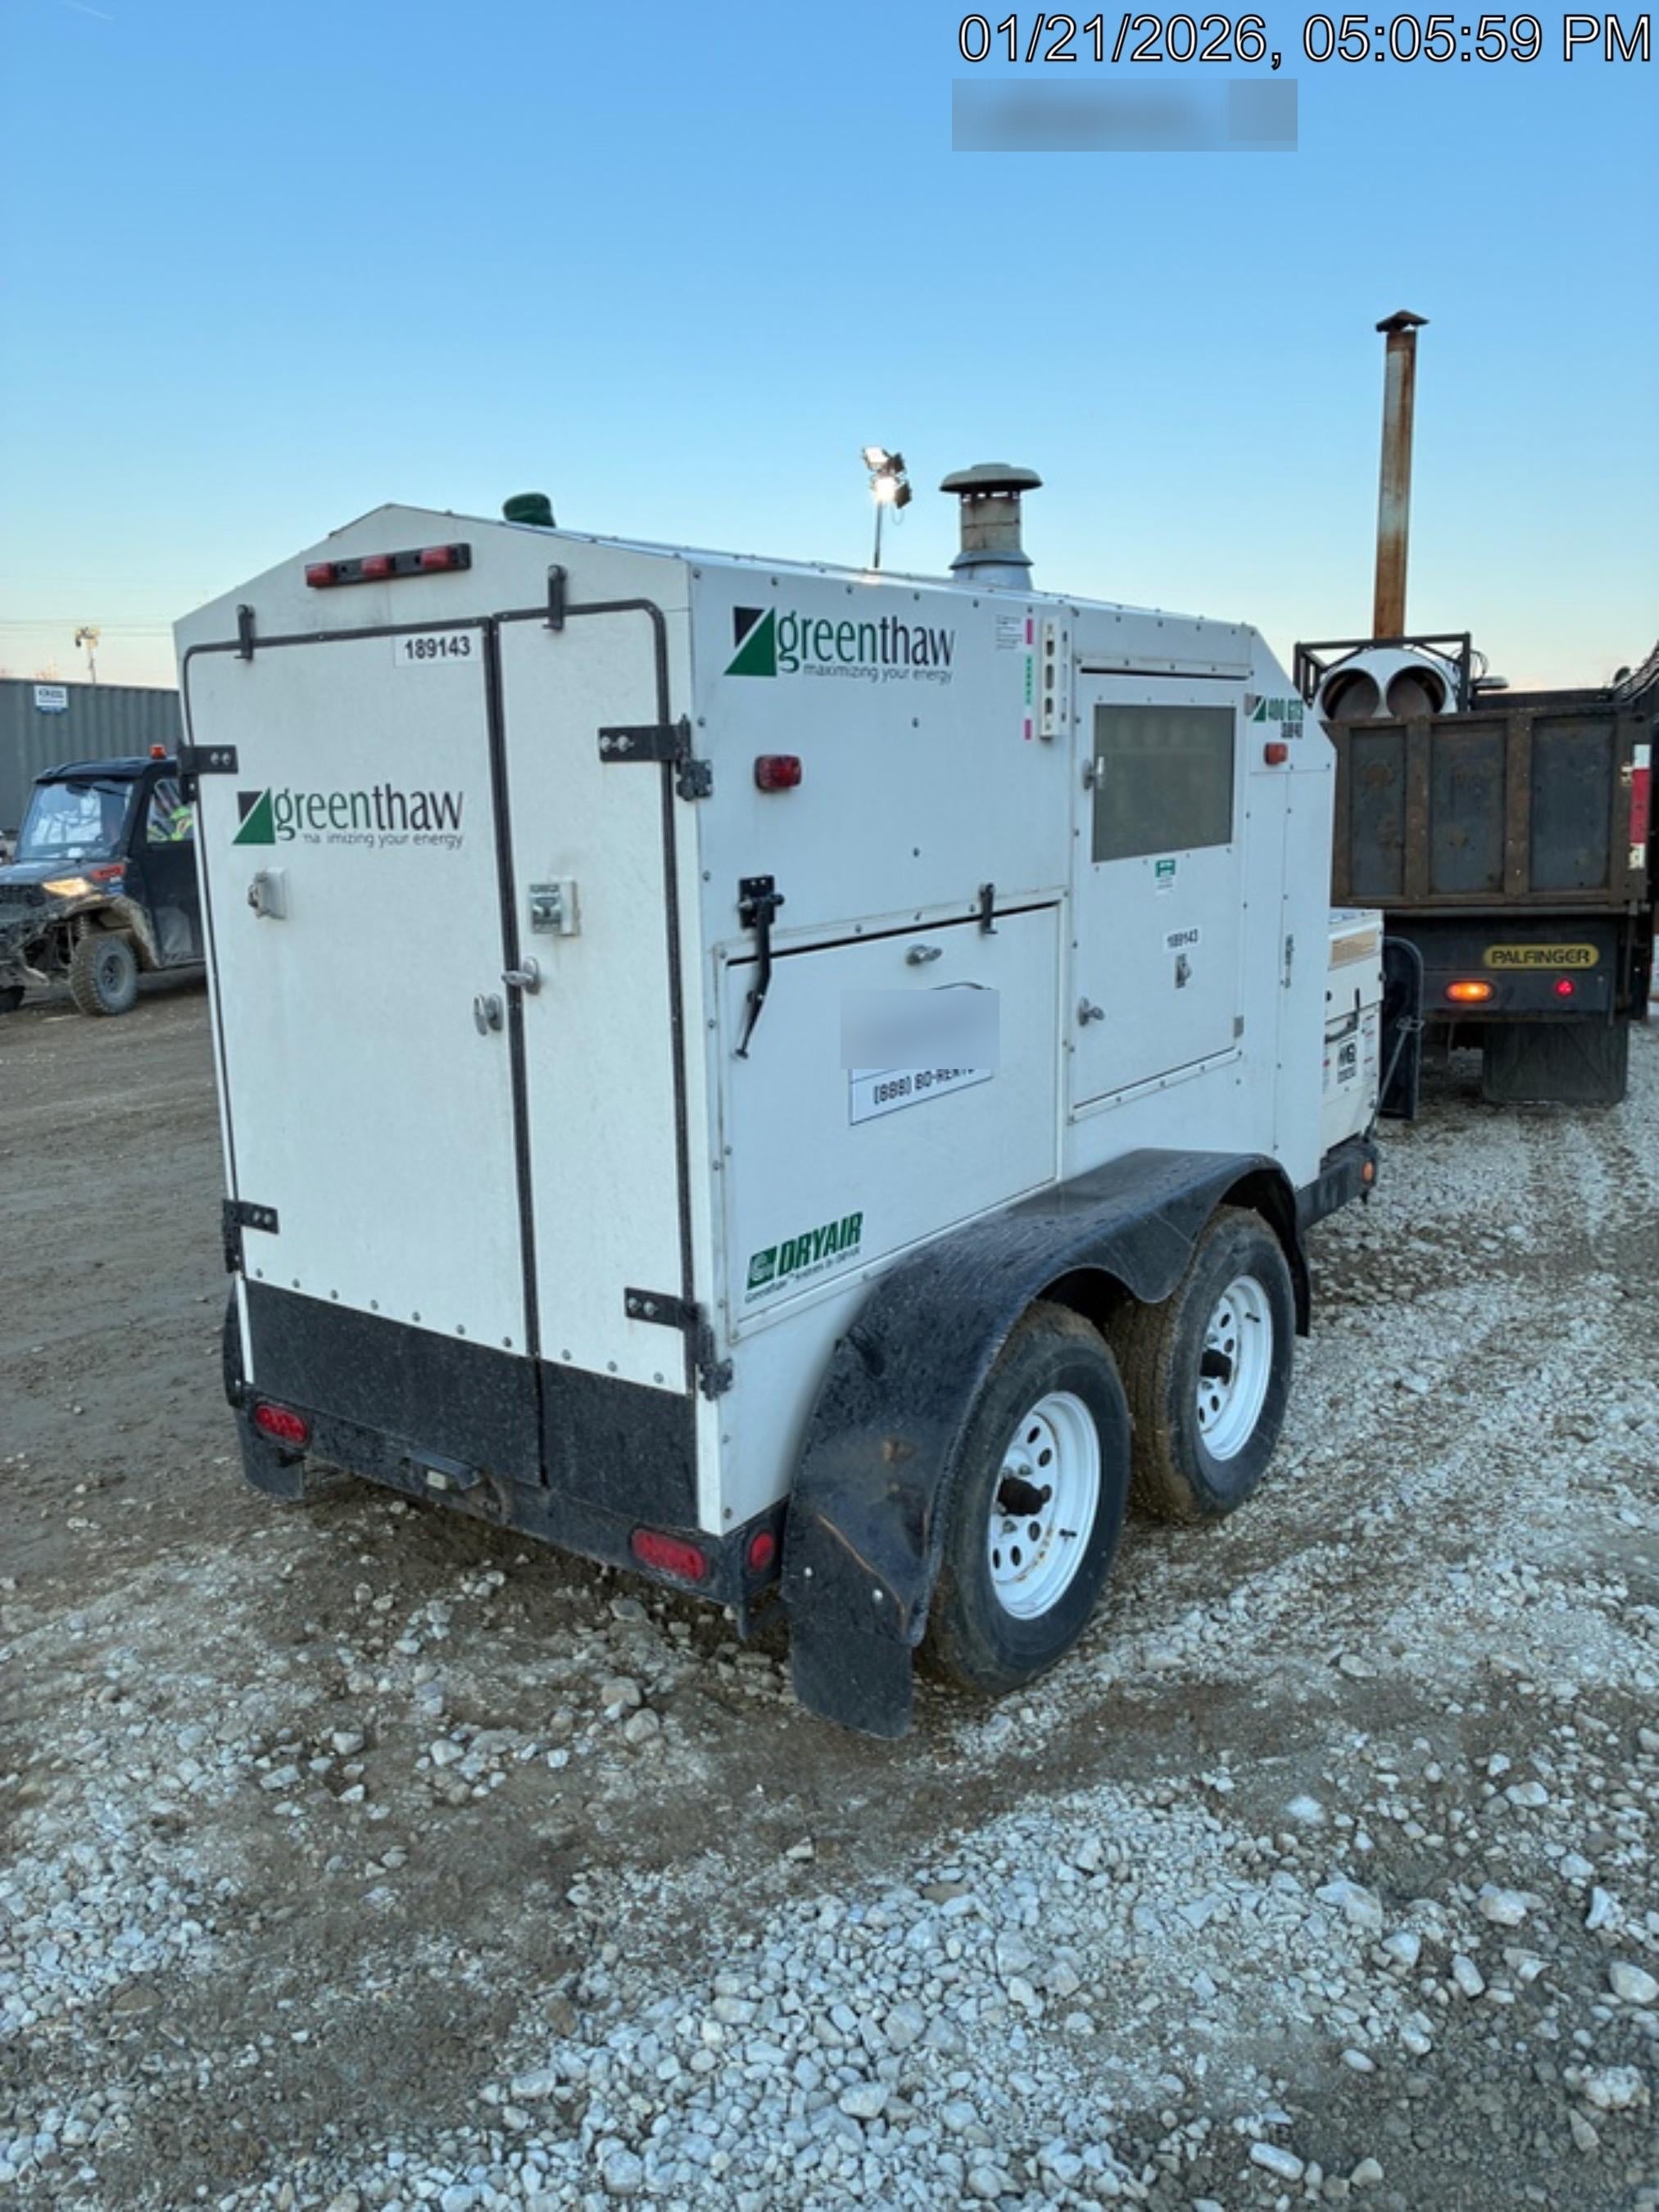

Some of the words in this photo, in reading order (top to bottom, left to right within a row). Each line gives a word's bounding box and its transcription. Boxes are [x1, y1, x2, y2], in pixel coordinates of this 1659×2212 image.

[405, 635, 470, 660] 189143
[777, 610, 956, 673] greenthaw
[803, 662, 878, 683] maximizing
[882, 666, 910, 684] your
[913, 669, 954, 687] energy
[274, 783, 465, 841] greenthaw
[302, 832, 374, 849] maimizing
[377, 832, 409, 849] your
[412, 832, 464, 850] energy
[1491, 948, 1591, 964] PALFINGER
[778, 1211, 863, 1276] DRYAIR
